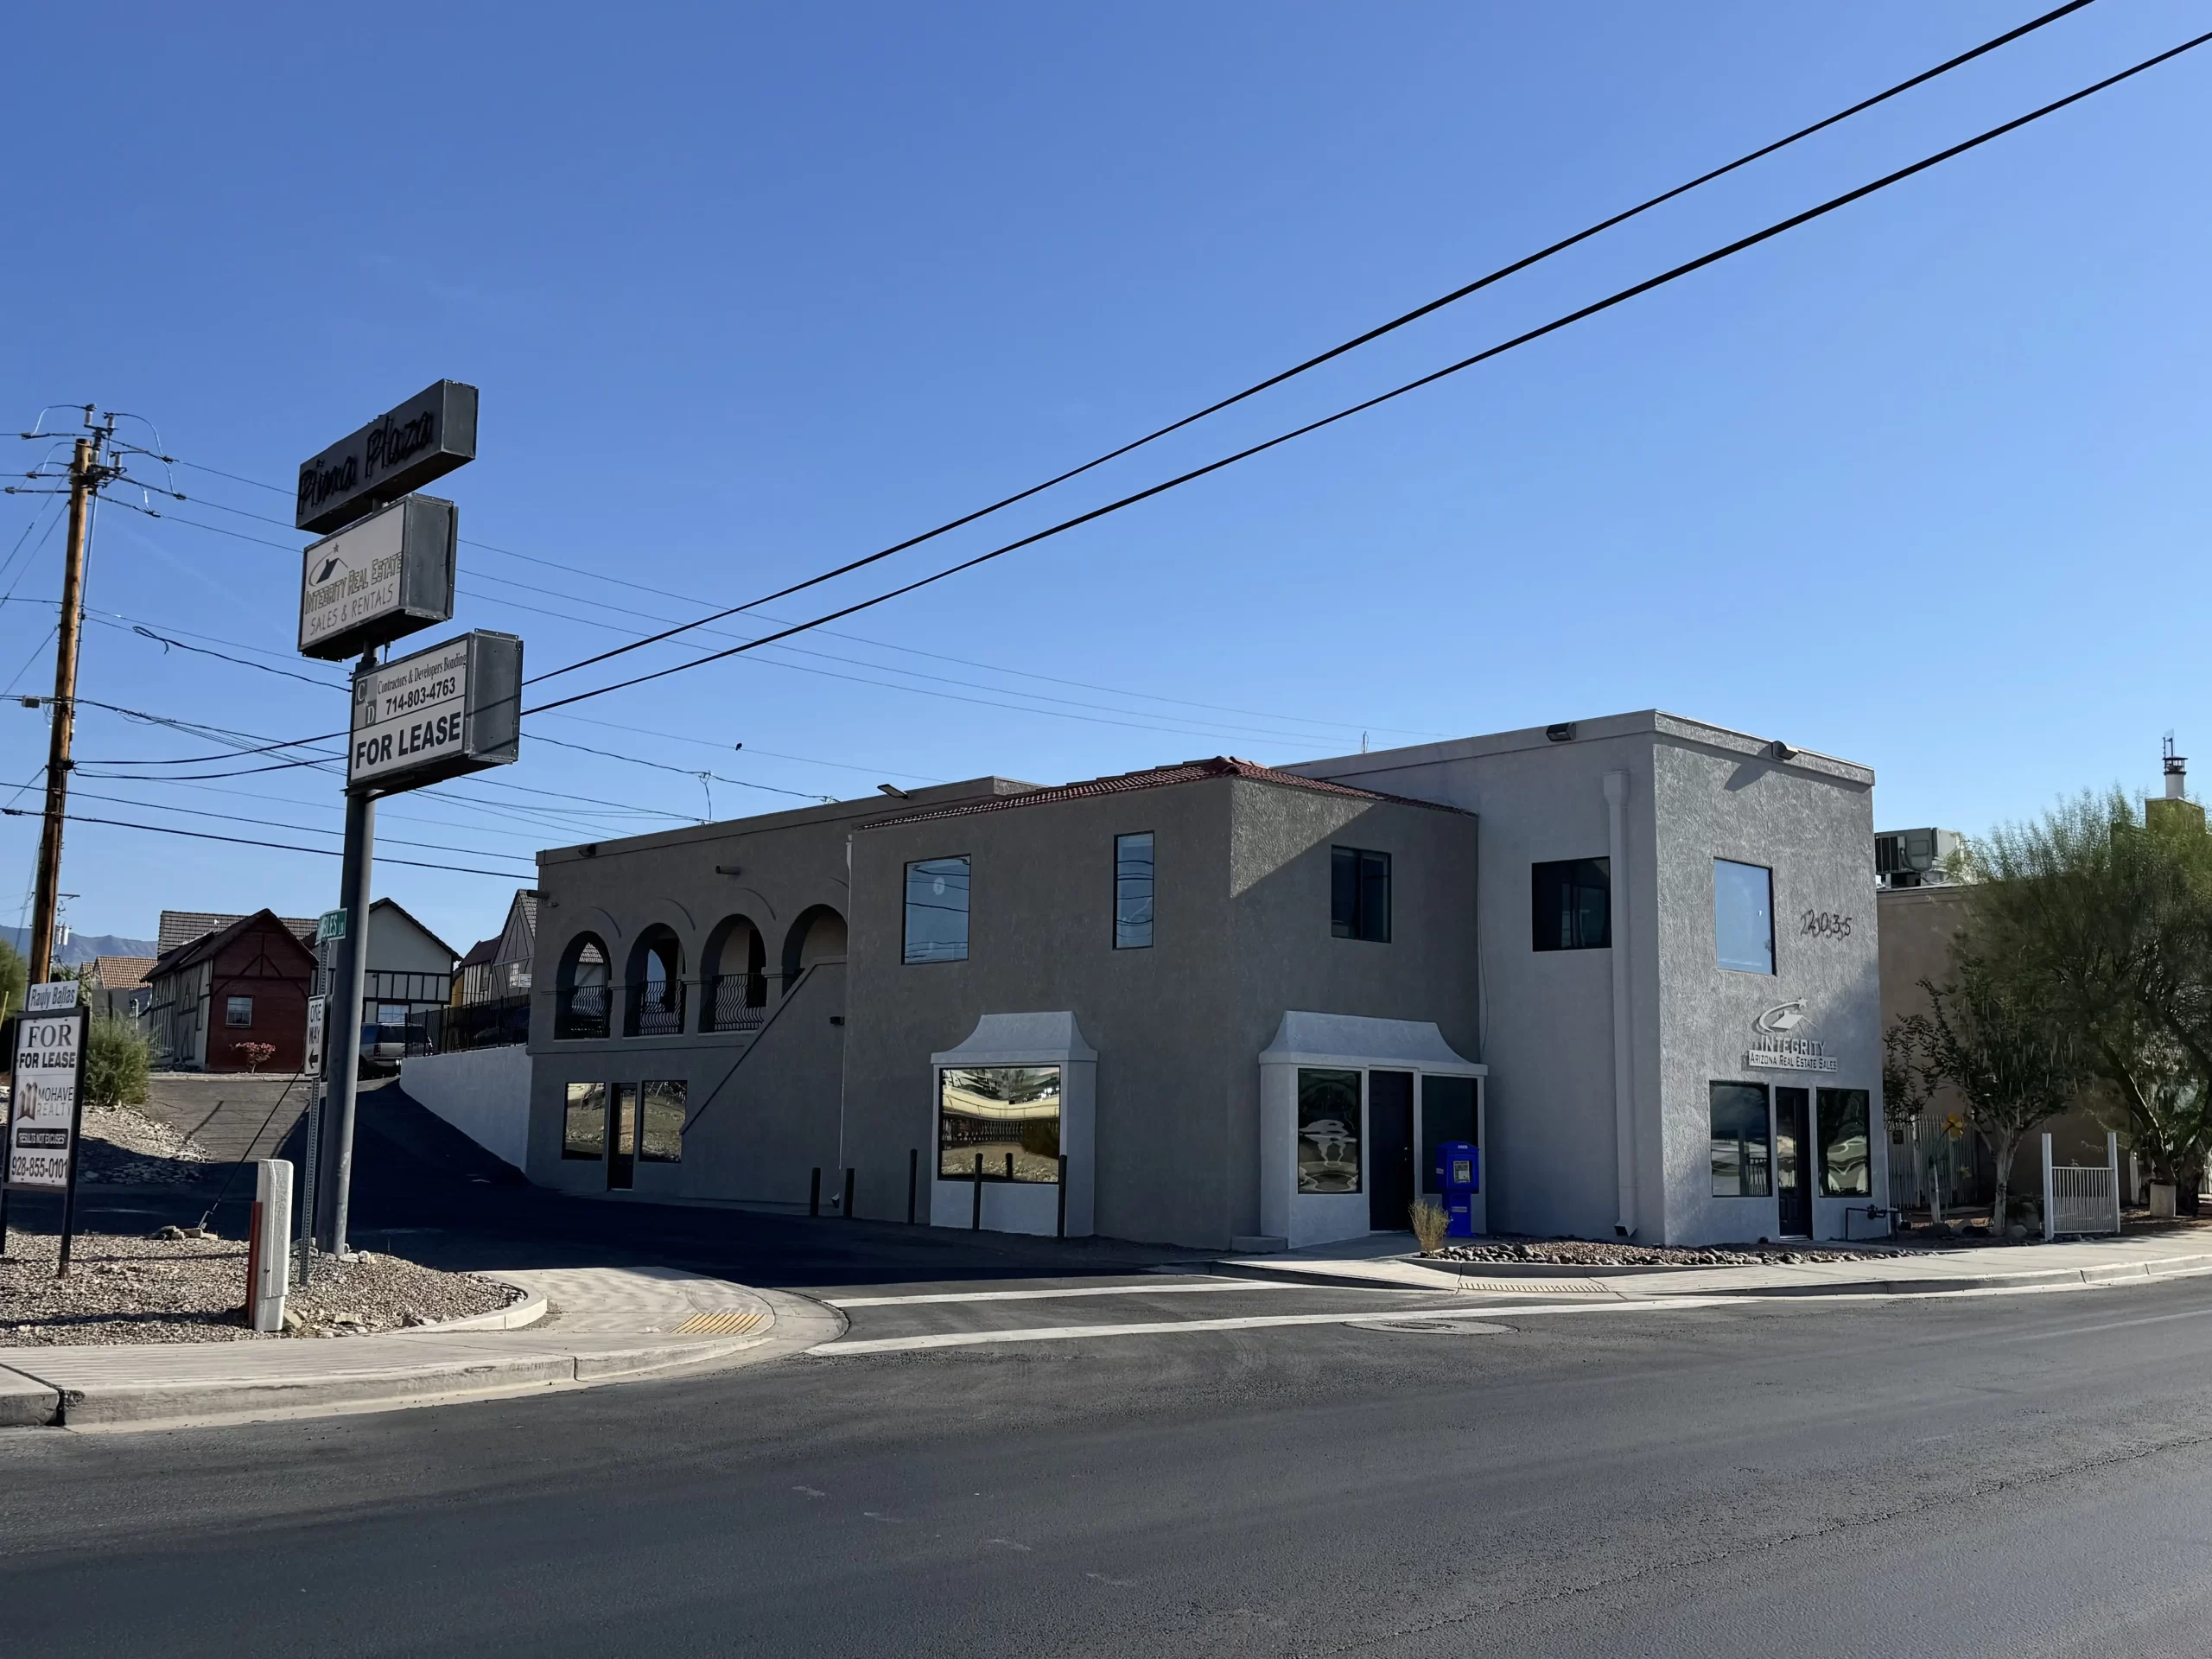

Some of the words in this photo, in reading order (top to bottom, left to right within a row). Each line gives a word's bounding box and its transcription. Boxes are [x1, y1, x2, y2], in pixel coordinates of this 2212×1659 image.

[365, 410, 434, 480] Plaza
[347, 567, 369, 596] REAL
[371, 551, 402, 585] ESTATE
[310, 607, 338, 636] SALES
[340, 604, 347, 622] &
[352, 582, 394, 619] RENTALS
[378, 675, 408, 695] Contractors
[408, 669, 414, 684] &
[415, 663, 443, 682] Developers
[443, 652, 467, 672] Bonding
[357, 683, 365, 702] C
[385, 676, 455, 715] 714-803-4763
[366, 705, 375, 724] D
[355, 734, 392, 769] FOR
[397, 711, 461, 757] LEASE
[1806, 908, 1853, 938] 2035
[309, 1003, 322, 1023] ONE
[27, 1024, 73, 1048] FOR
[308, 1026, 321, 1045] WAY
[1761, 1035, 1827, 1057] INTEGRITY
[19, 1052, 40, 1069] FOR
[41, 1051, 76, 1069] LEASE
[1751, 1052, 1777, 1065] ARIZONA
[1779, 1054, 1795, 1067] REAL
[1796, 1056, 1817, 1069] ESTATE
[1818, 1058, 1837, 1071] SALES
[38, 1086, 74, 1102] MOHAVE
[36, 1102, 73, 1116] REALTY
[11, 1155, 68, 1179] 928-855-0101
